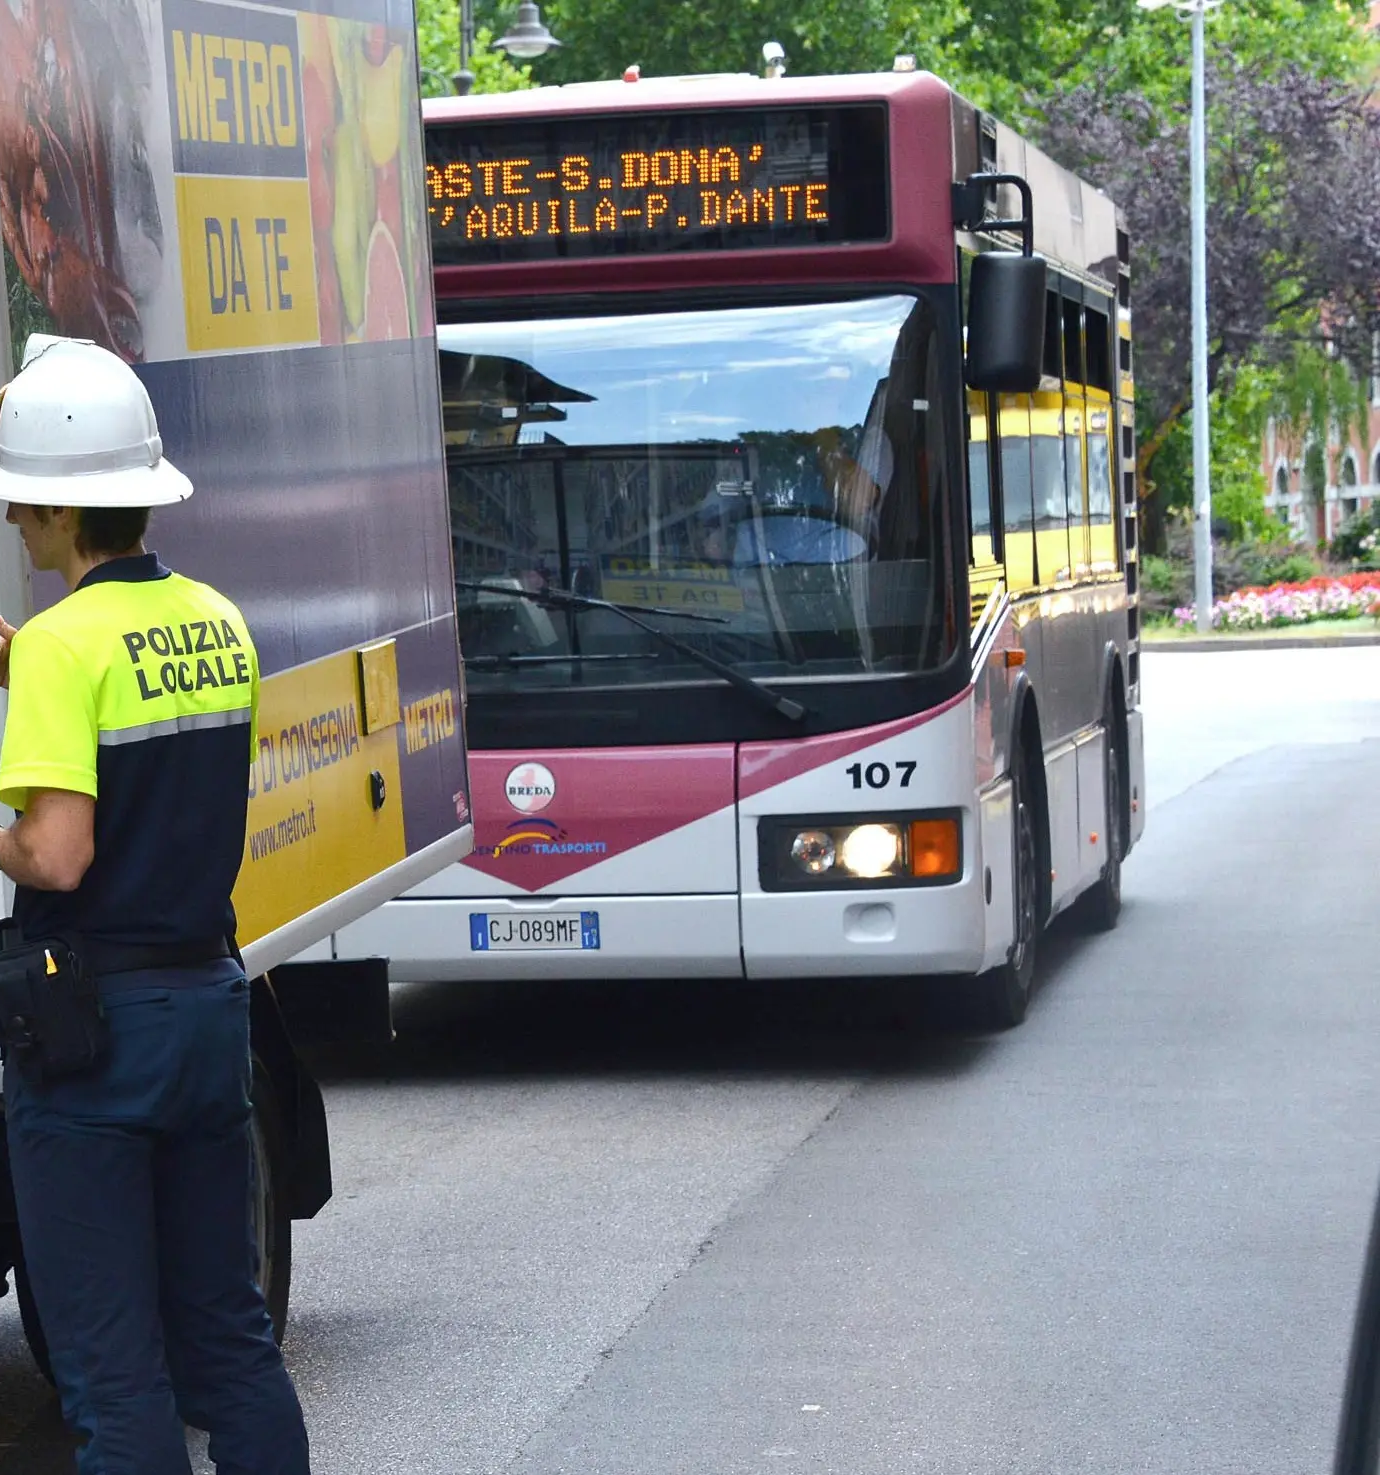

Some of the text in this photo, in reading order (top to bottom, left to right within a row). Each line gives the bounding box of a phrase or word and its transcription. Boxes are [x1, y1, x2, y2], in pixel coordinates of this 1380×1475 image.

[172, 29, 298, 148] METRO
[204, 217, 292, 314] DA TE
[122, 619, 242, 664] POLIZIA
[135, 653, 250, 701] LOCALE
[259, 729, 278, 793] DI
[279, 702, 361, 784] CONSEGNA
[404, 688, 455, 755] METRO
[508, 786, 552, 796] BREDA
[846, 761, 917, 789] 107
[249, 800, 317, 862] www.metro.it
[533, 841, 607, 855] TRASPORTI
